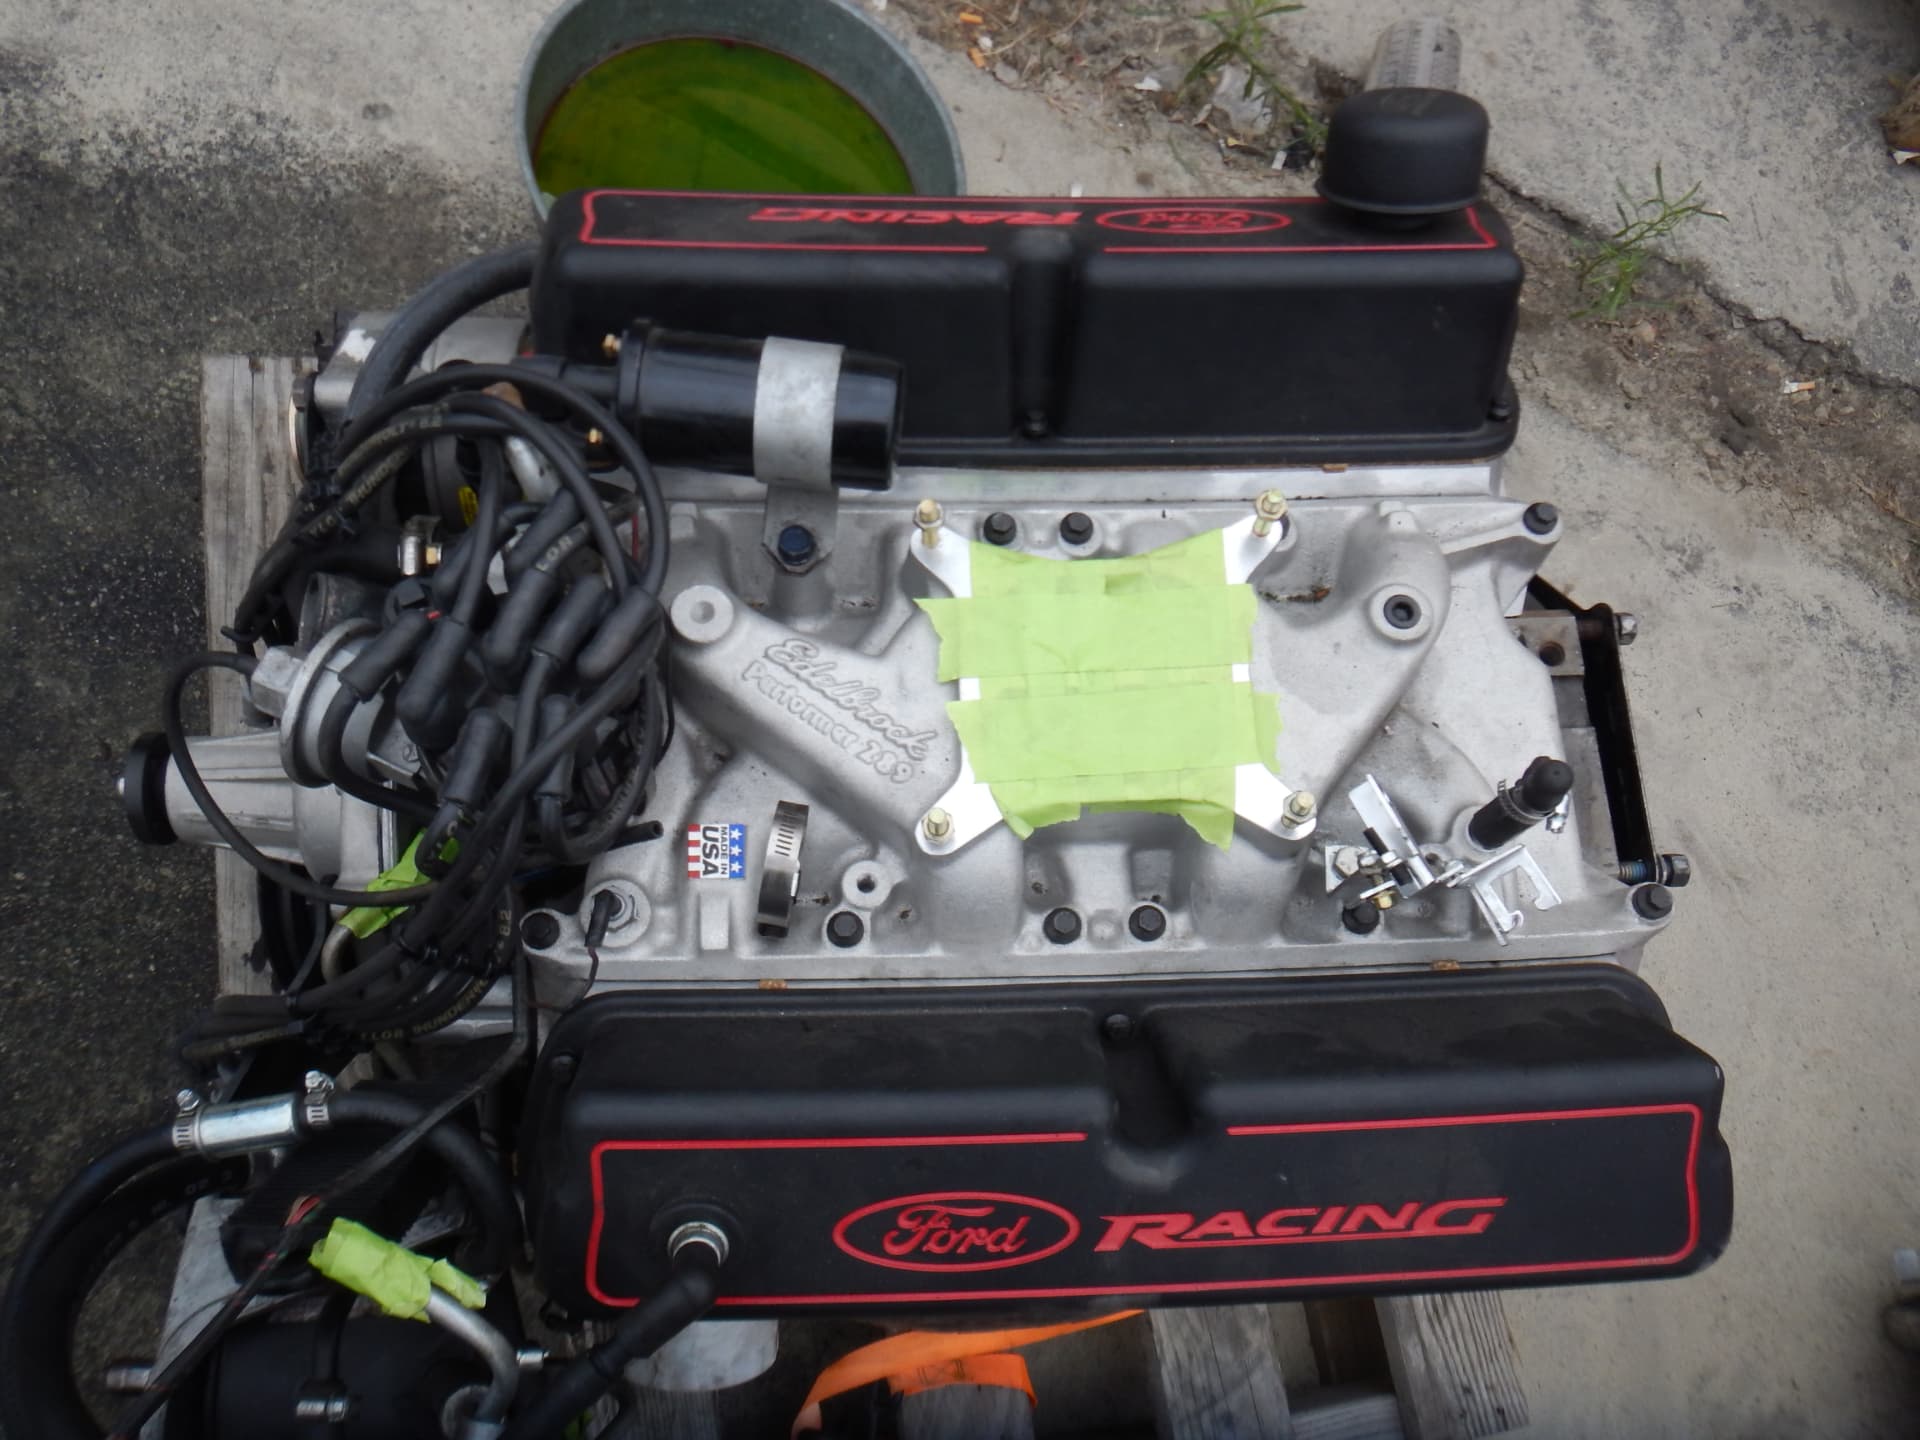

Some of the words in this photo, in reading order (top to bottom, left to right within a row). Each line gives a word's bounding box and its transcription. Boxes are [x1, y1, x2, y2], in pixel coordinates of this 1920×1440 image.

[748, 207, 1084, 225] RACING
[1138, 211, 1252, 231] Ford
[763, 638, 938, 761] Edelbrock
[742, 660, 859, 750] Performer
[856, 740, 914, 784] 289
[702, 826, 720, 876] USA
[720, 826, 729, 859] MADE
[720, 863, 729, 875] IN
[883, 1204, 1027, 1255] Ford
[1093, 1197, 1508, 1253] RACING
